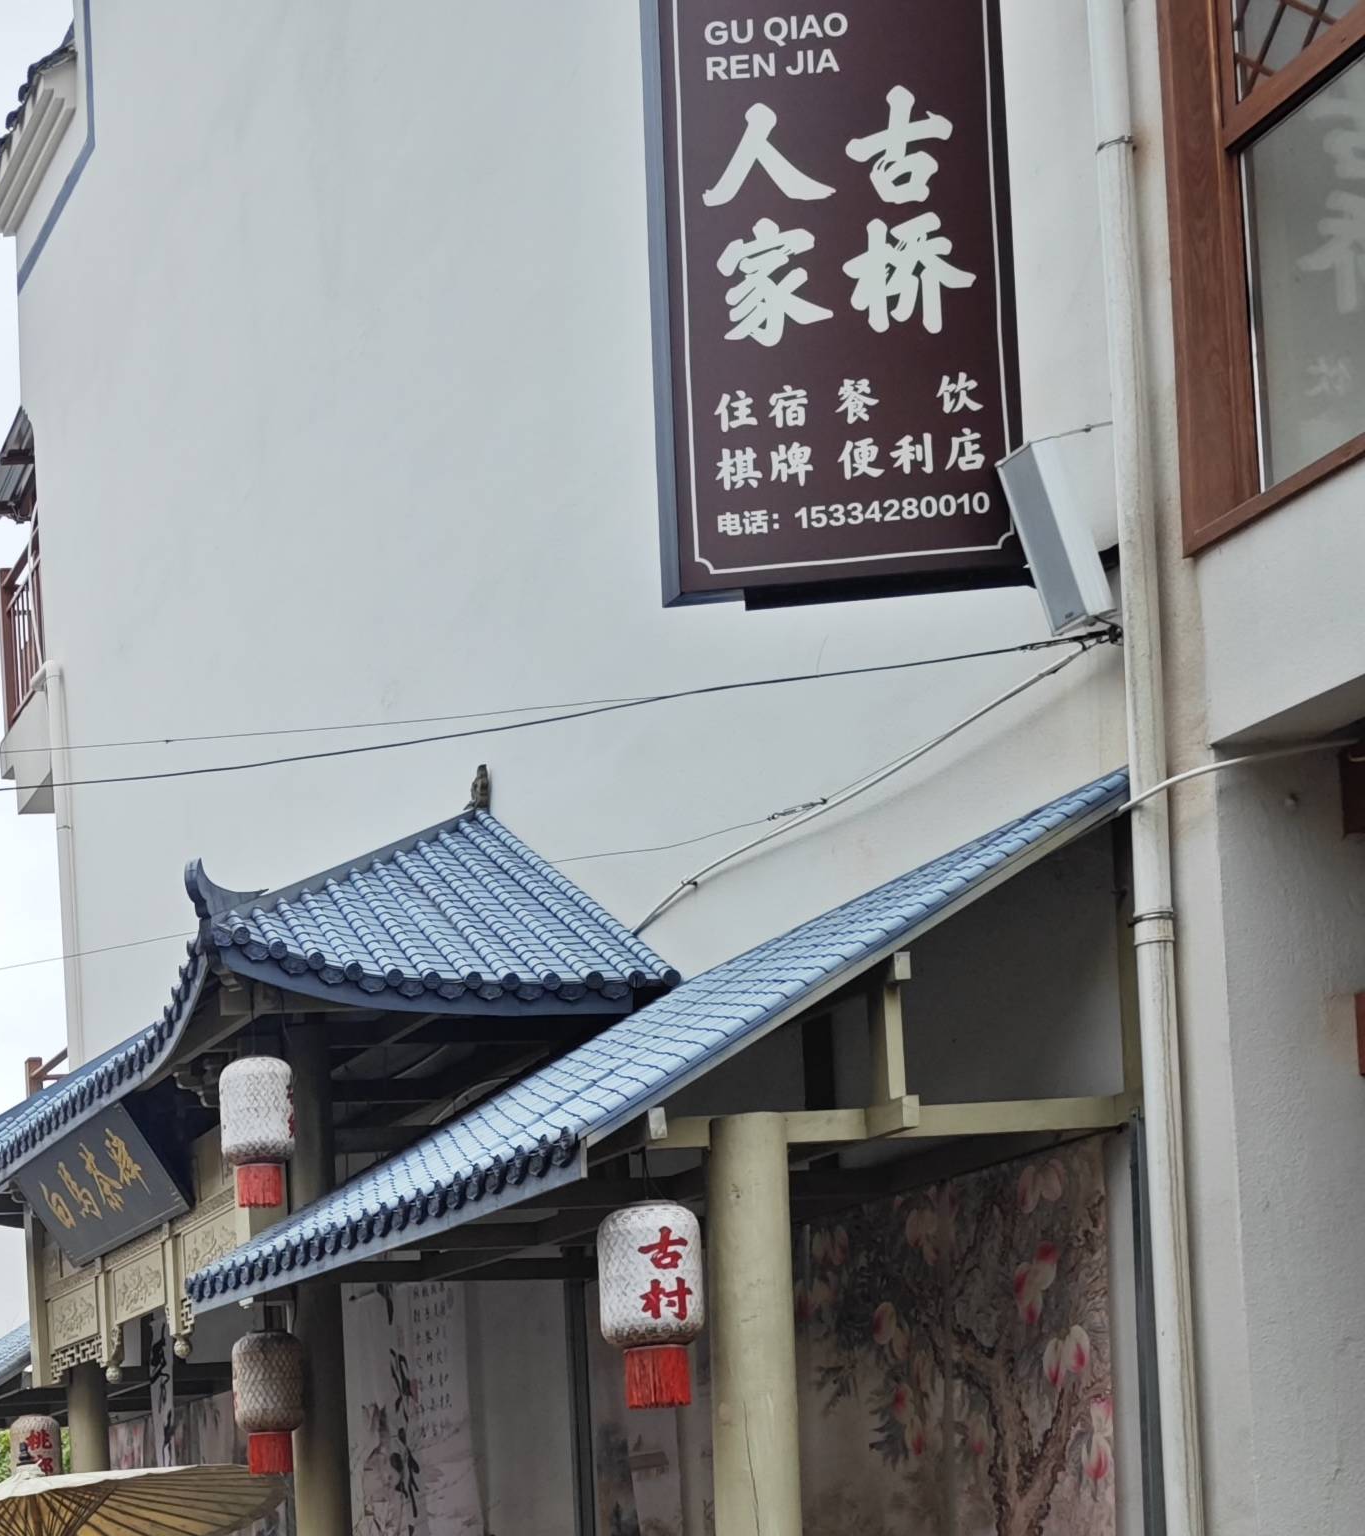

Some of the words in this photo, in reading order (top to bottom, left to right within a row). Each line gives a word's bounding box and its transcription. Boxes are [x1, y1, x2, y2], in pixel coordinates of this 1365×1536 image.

[704, 17, 754, 46] GU
[763, 12, 849, 45] QIAO
[705, 54, 777, 81] REN
[785, 48, 840, 75] JIA
[701, 102, 837, 347] 人家
[842, 84, 977, 335] 古桥
[714, 384, 810, 433] 住宿
[715, 443, 815, 492] 棋牌
[837, 427, 987, 481] 便利店
[637, 1225, 693, 1322] 古村
